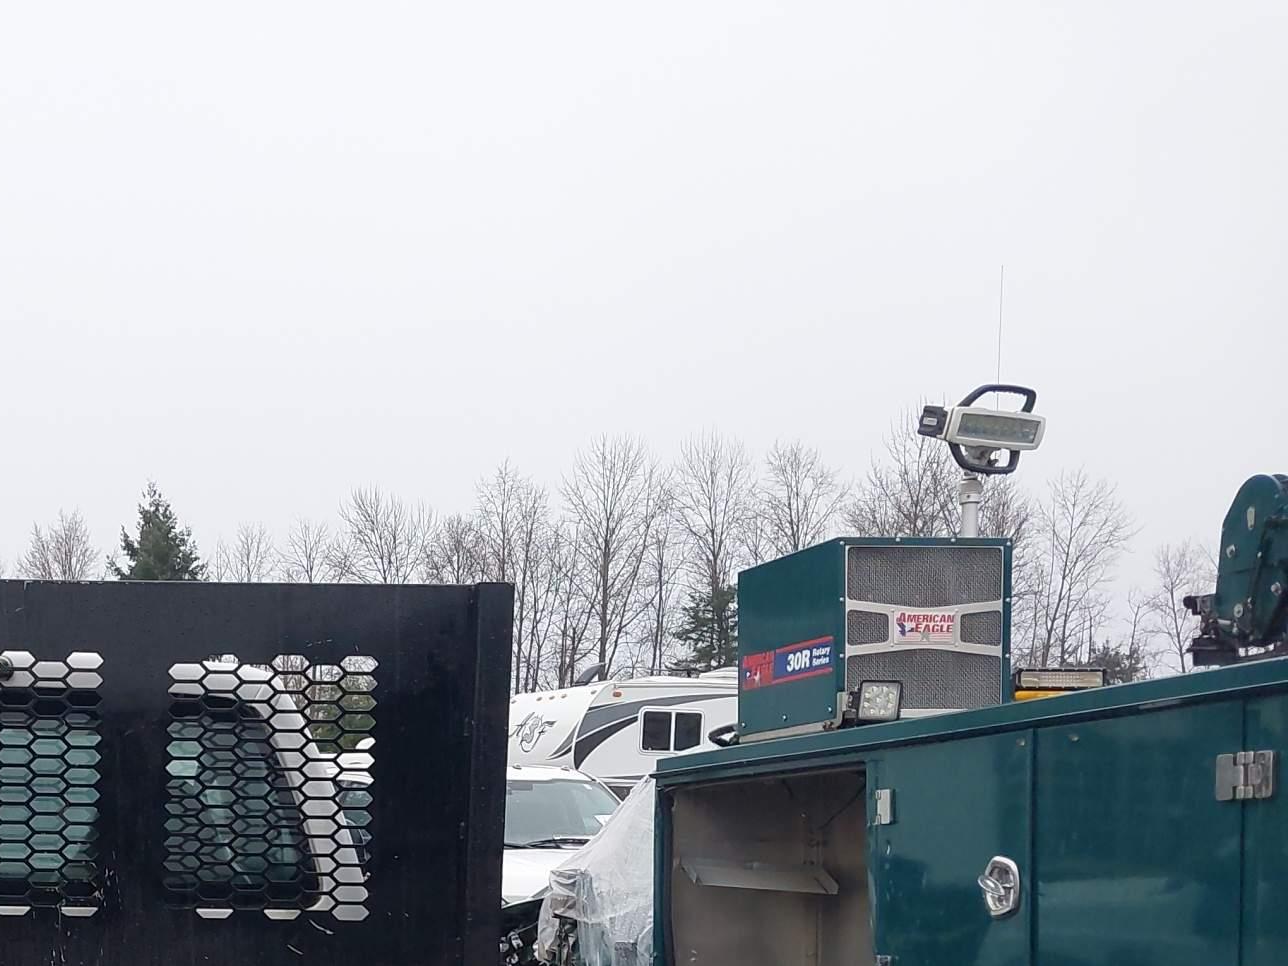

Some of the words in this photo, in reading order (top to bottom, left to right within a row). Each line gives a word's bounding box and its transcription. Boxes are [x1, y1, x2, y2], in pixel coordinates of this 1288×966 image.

[898, 612, 955, 623] AMERICAN
[914, 623, 953, 633] EAGLE
[812, 647, 831, 657] Rotary
[786, 649, 811, 672] 30R
[812, 656, 830, 667] Series
